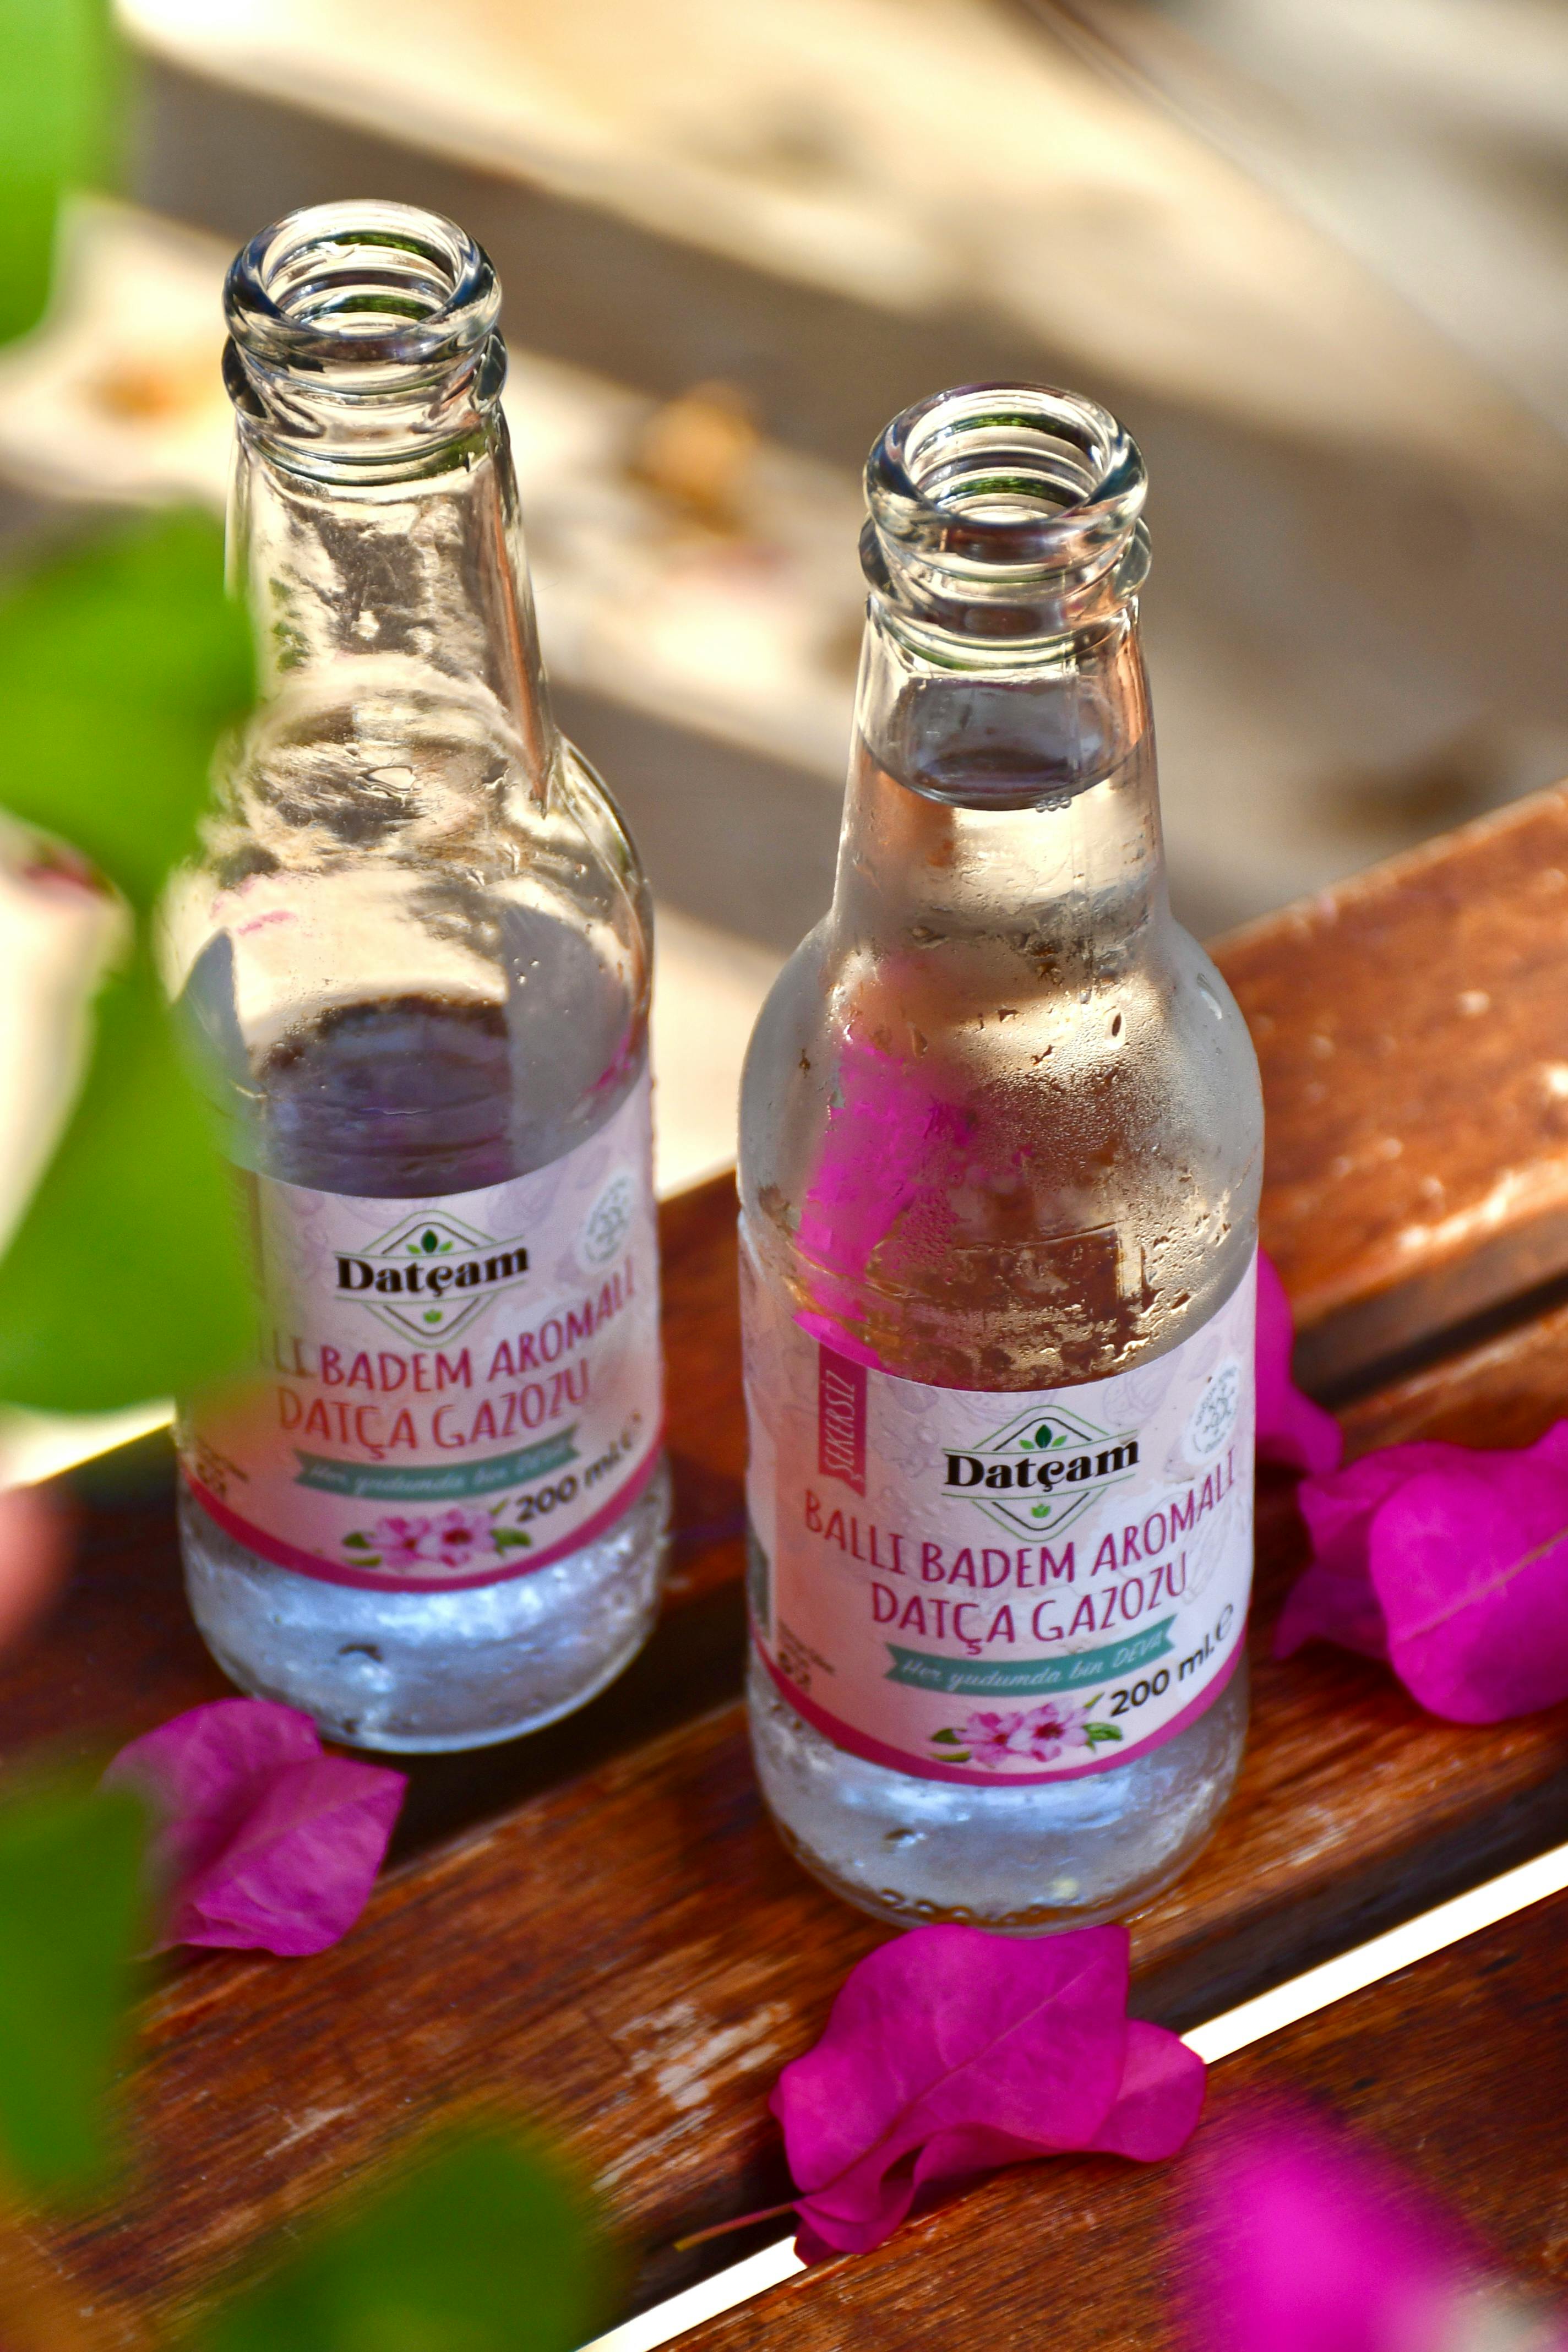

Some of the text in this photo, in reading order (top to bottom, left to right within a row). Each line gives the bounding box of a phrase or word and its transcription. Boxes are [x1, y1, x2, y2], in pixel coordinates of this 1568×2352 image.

[336, 1246, 529, 1295] Datçam
[320, 1346, 472, 1392] BADEM
[487, 1253, 635, 1382] AROMALI
[277, 1386, 417, 1460] DATÇA
[432, 1358, 589, 1449] GAZOZU
[945, 1440, 1140, 1493] Datçam
[516, 1475, 578, 1523] 200
[805, 1445, 1235, 1588] BALLI BADEM AROMALI
[873, 1581, 1015, 1655] DATÇA
[1032, 1551, 1188, 1642] GAZOZU
[901, 1630, 1164, 1692] Her yudumda bin DEVA
[1110, 1668, 1169, 1717] 200
